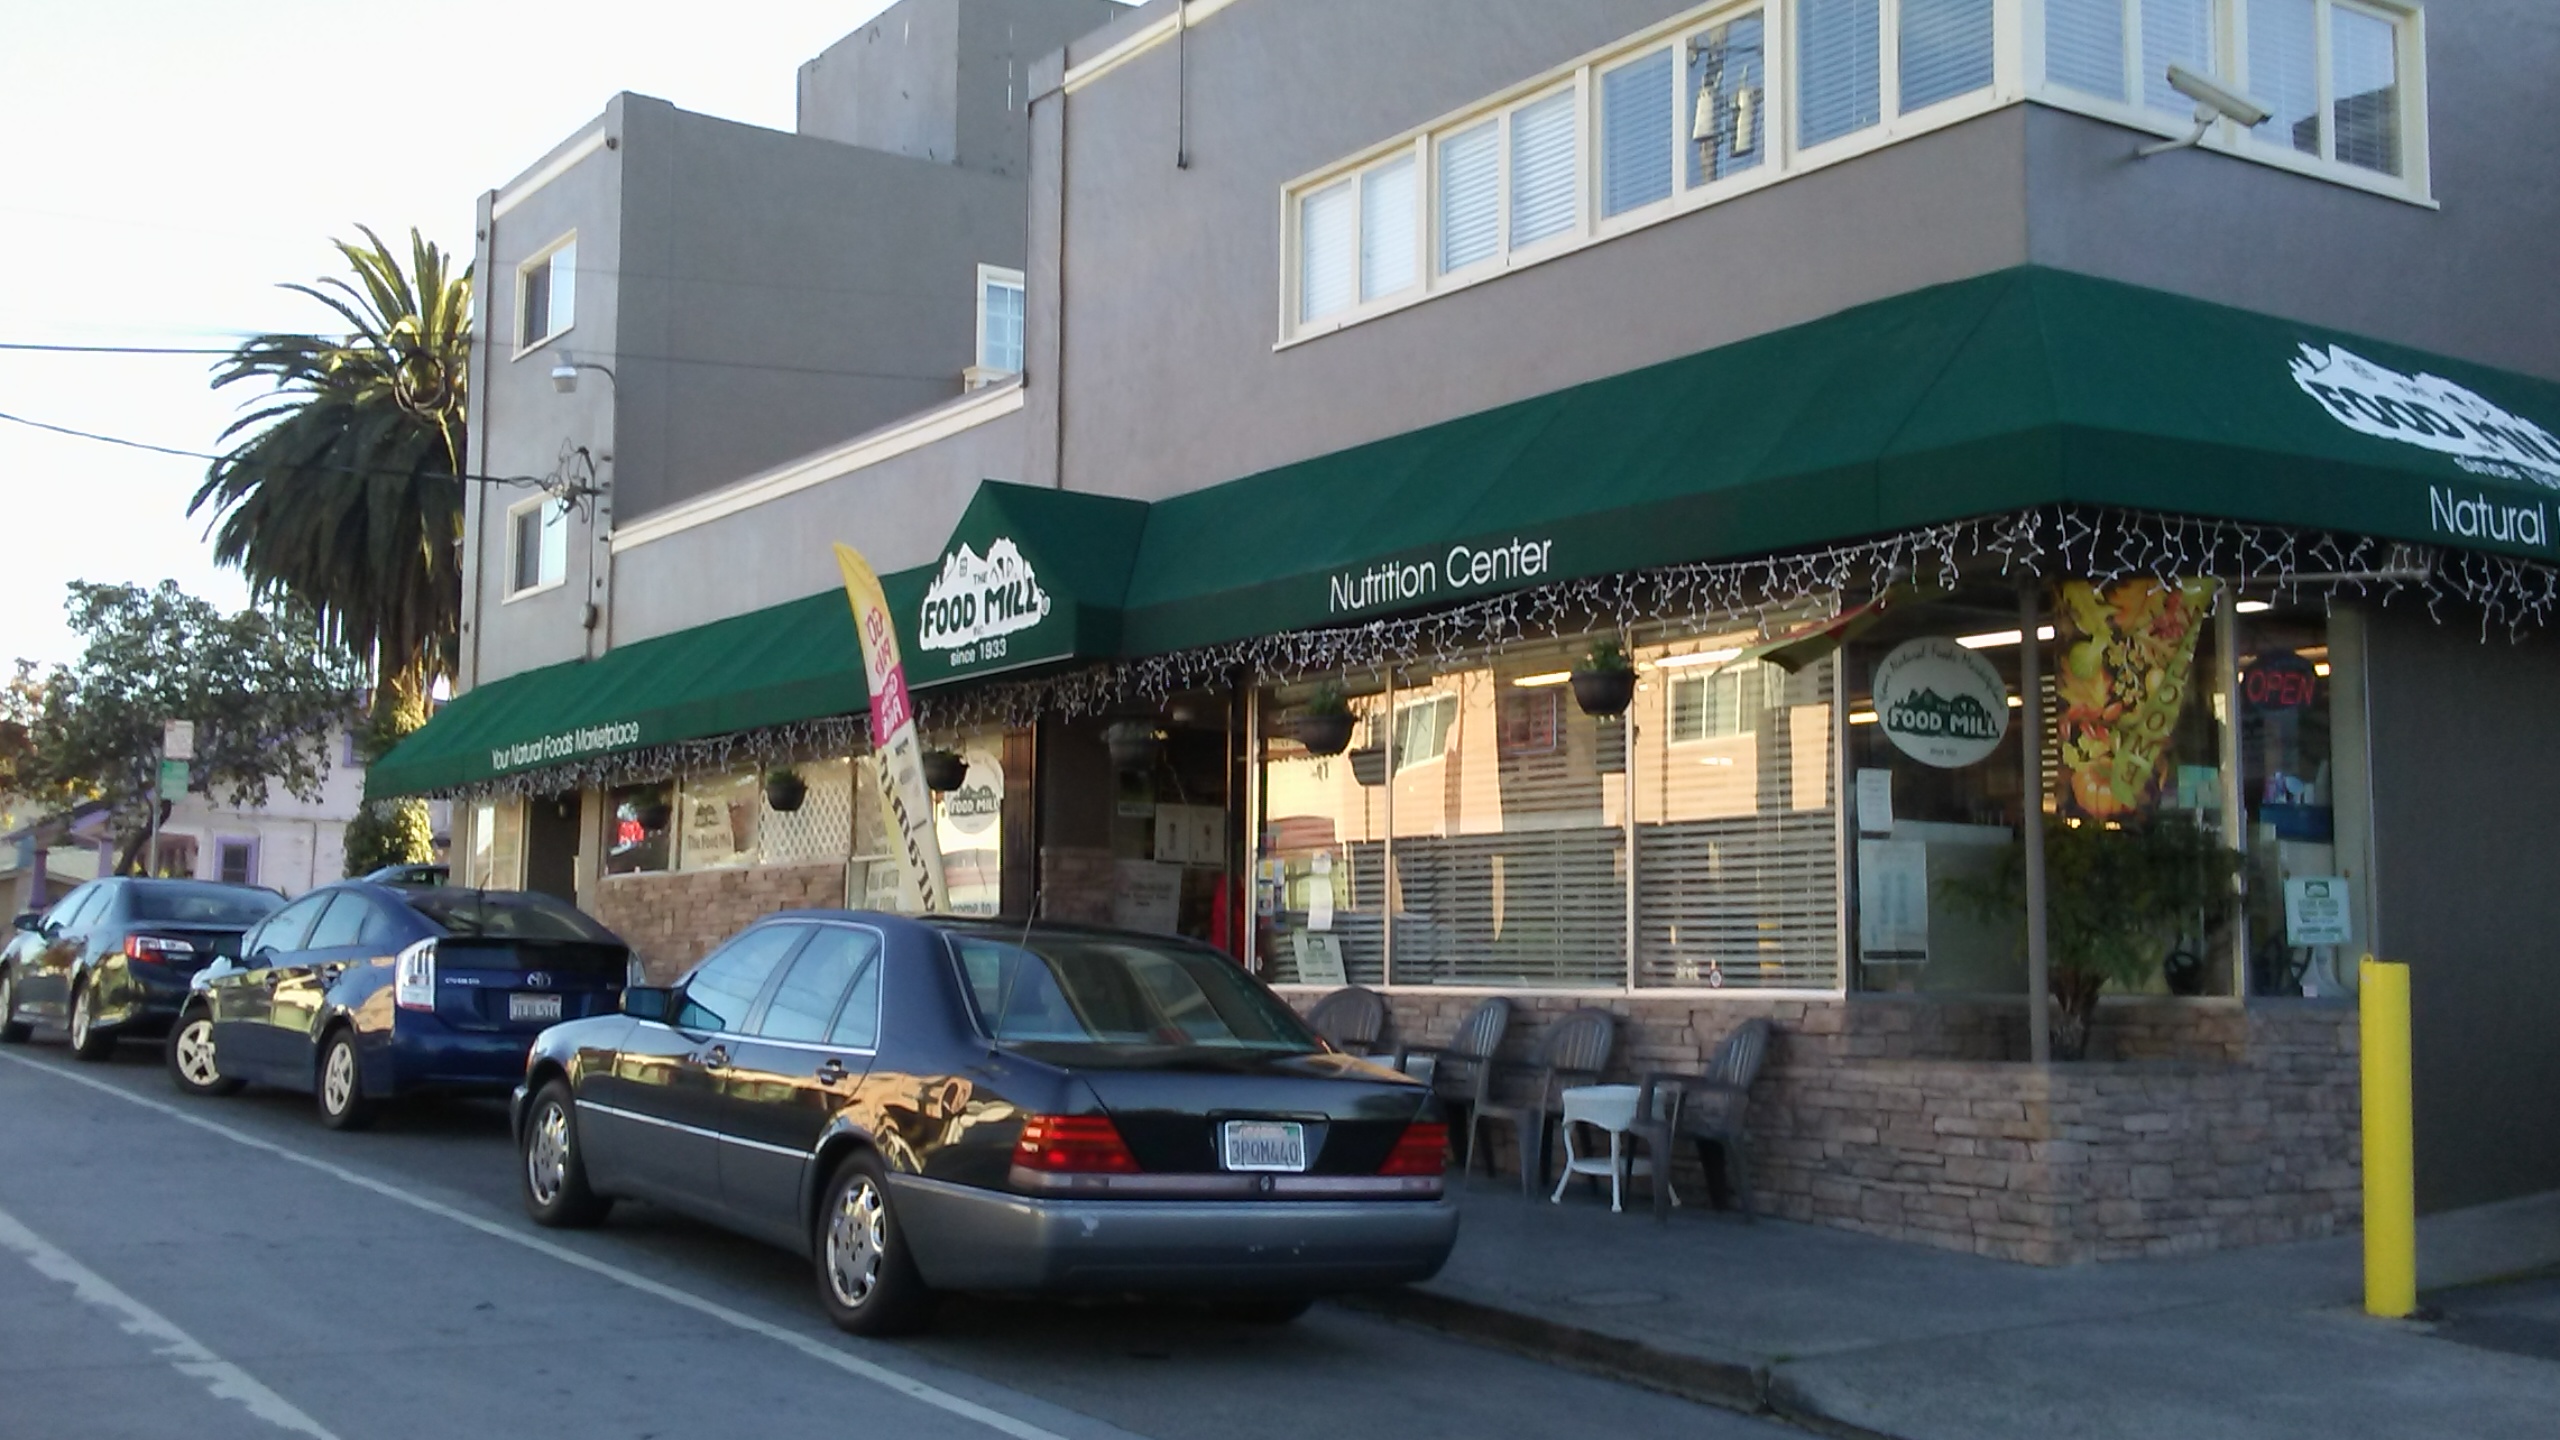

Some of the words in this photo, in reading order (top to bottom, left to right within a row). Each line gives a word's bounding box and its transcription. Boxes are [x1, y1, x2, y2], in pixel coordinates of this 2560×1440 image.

[2304, 379, 2467, 440] FOOD
[2430, 485, 2546, 546] Natural
[1329, 560, 1437, 614] Nutrition
[1446, 536, 1553, 588] Center
[924, 592, 976, 639] FOOD
[984, 577, 1038, 626] MILL
[950, 647, 976, 667] since
[980, 637, 1007, 660] 1933
[2246, 668, 2316, 705] OPEN
[492, 749, 510, 770] Your
[511, 737, 544, 766] Natural
[544, 731, 574, 759] Foods
[574, 720, 640, 751] Marketplace
[1890, 706, 1943, 731] FOOD
[1950, 713, 1999, 736] MILL
